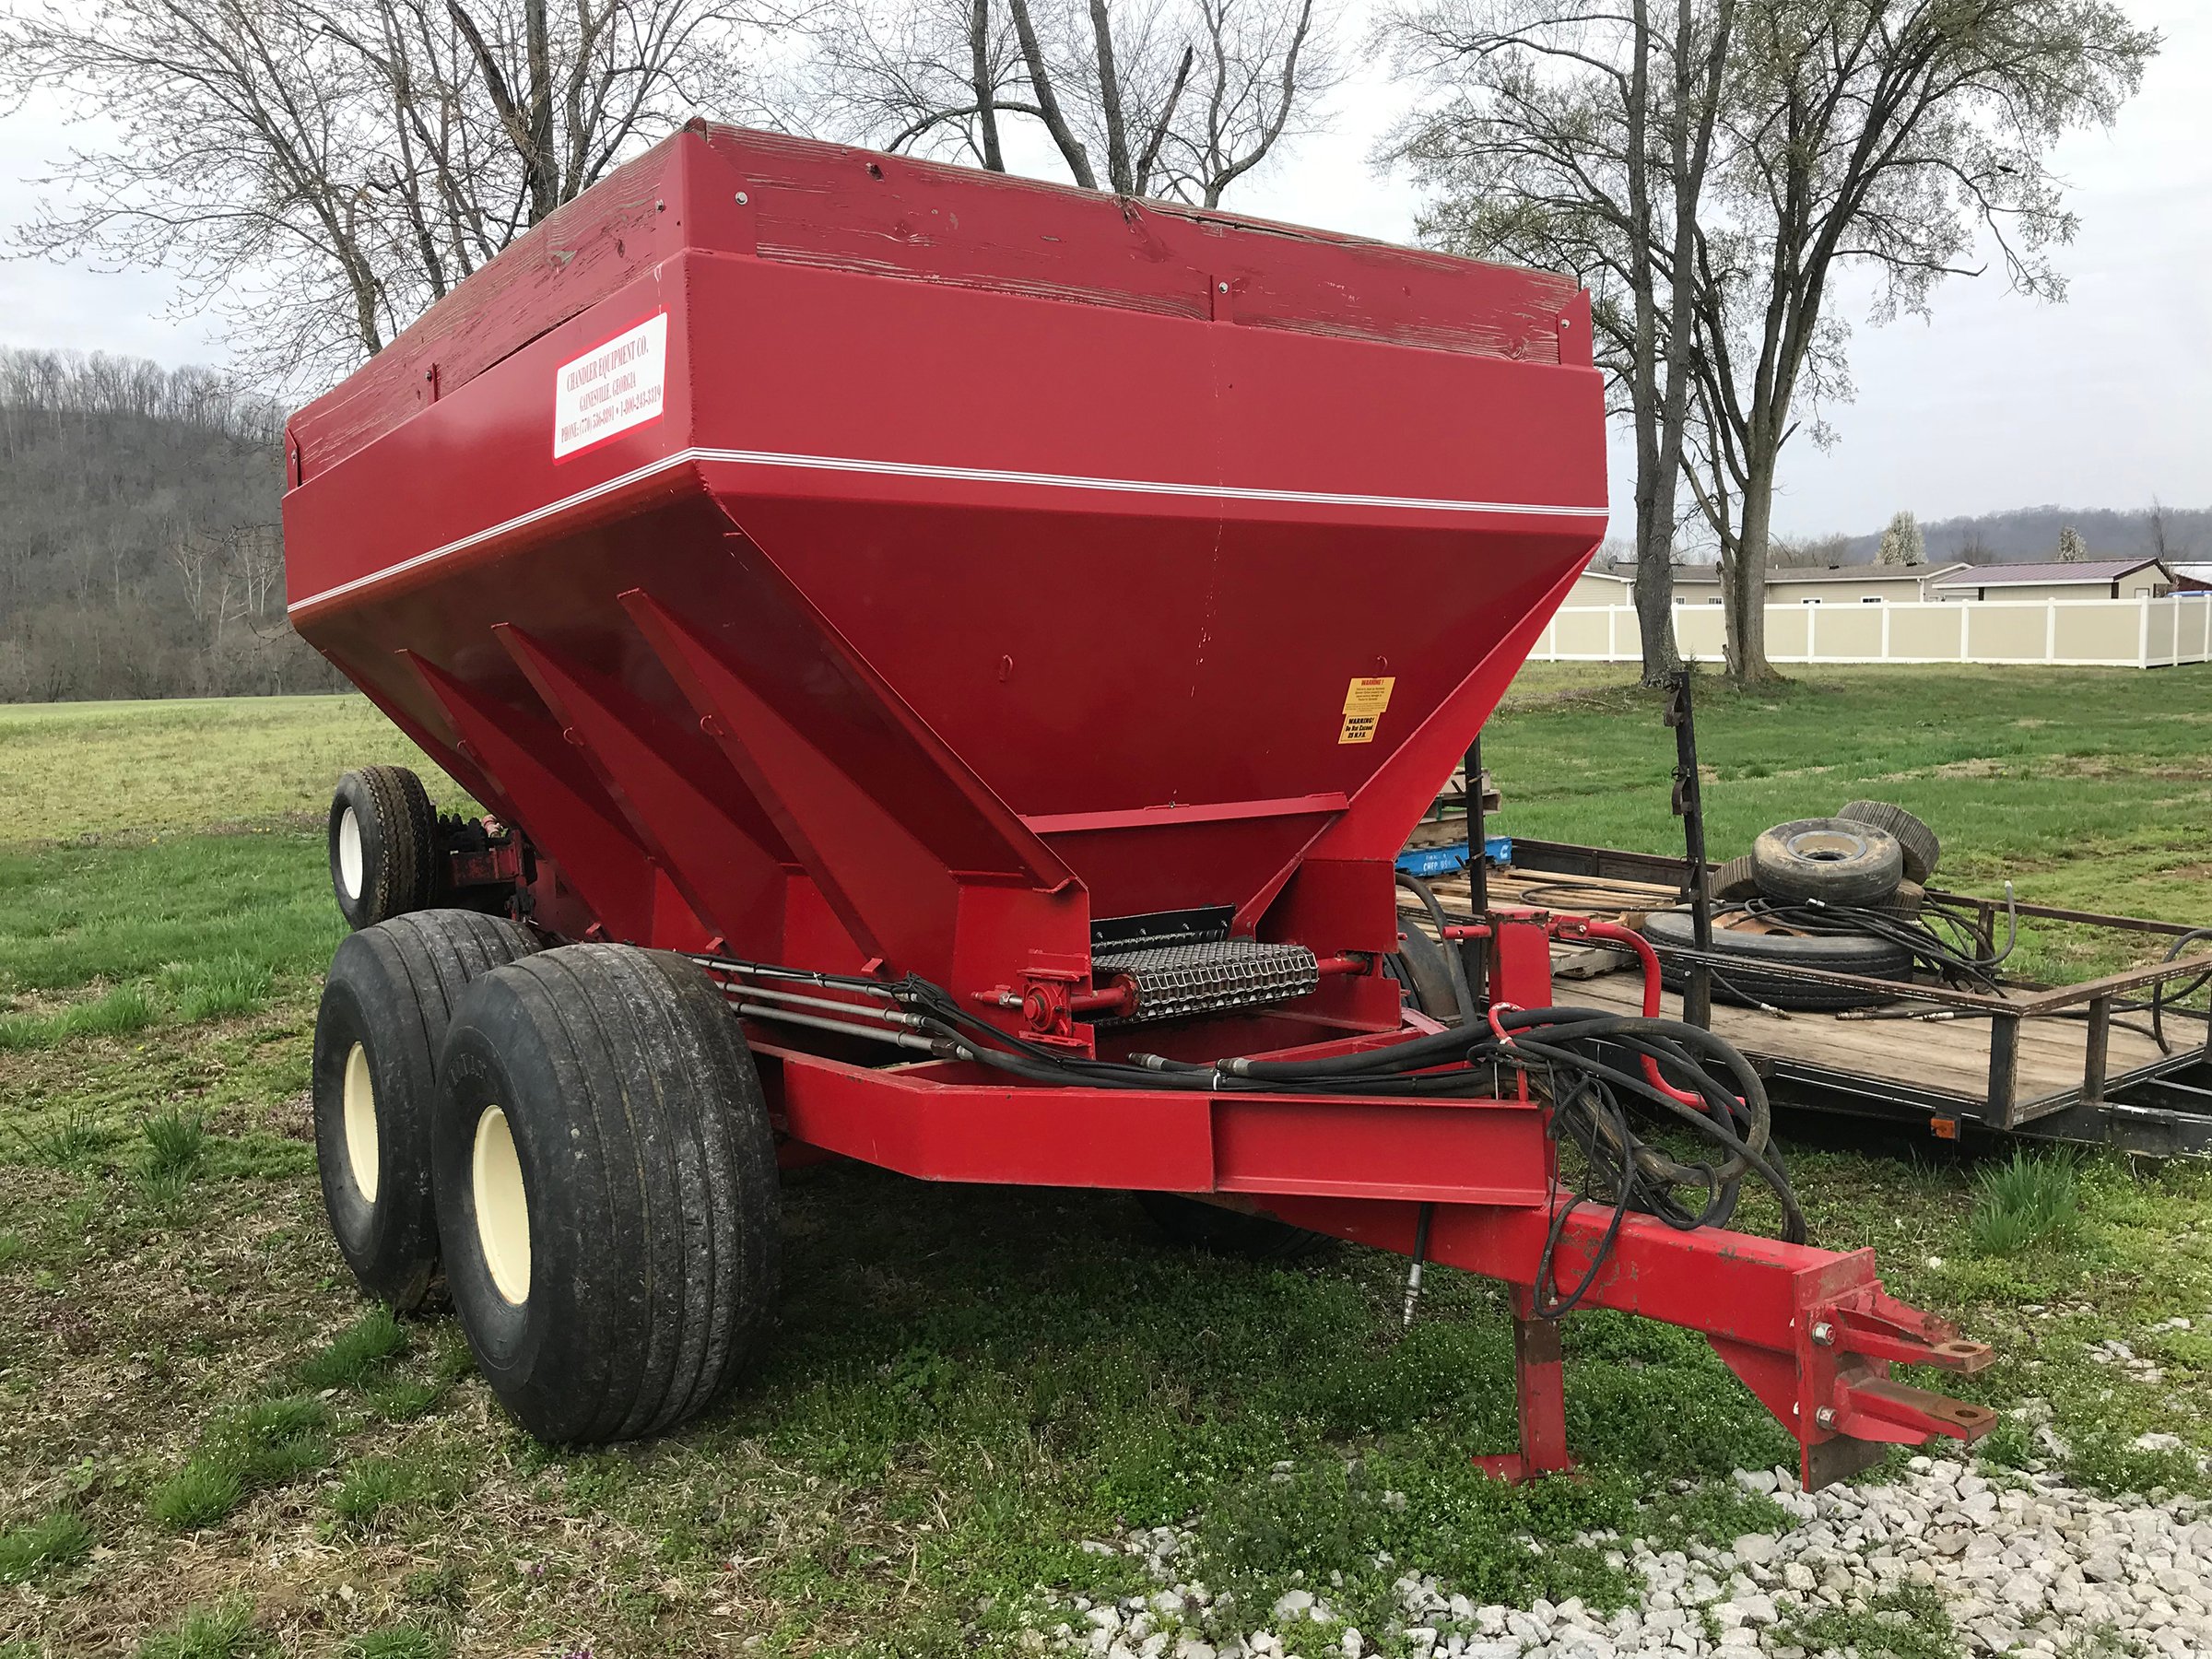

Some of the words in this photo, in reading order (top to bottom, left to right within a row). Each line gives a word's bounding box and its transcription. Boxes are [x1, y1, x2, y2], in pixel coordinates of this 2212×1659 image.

[567, 360, 597, 392] CHANDLER
[599, 340, 635, 380] EQUIPMENT
[637, 335, 649, 358] CO.
[613, 371, 637, 396] GEORGIA
[561, 419, 579, 443] PHONE:
